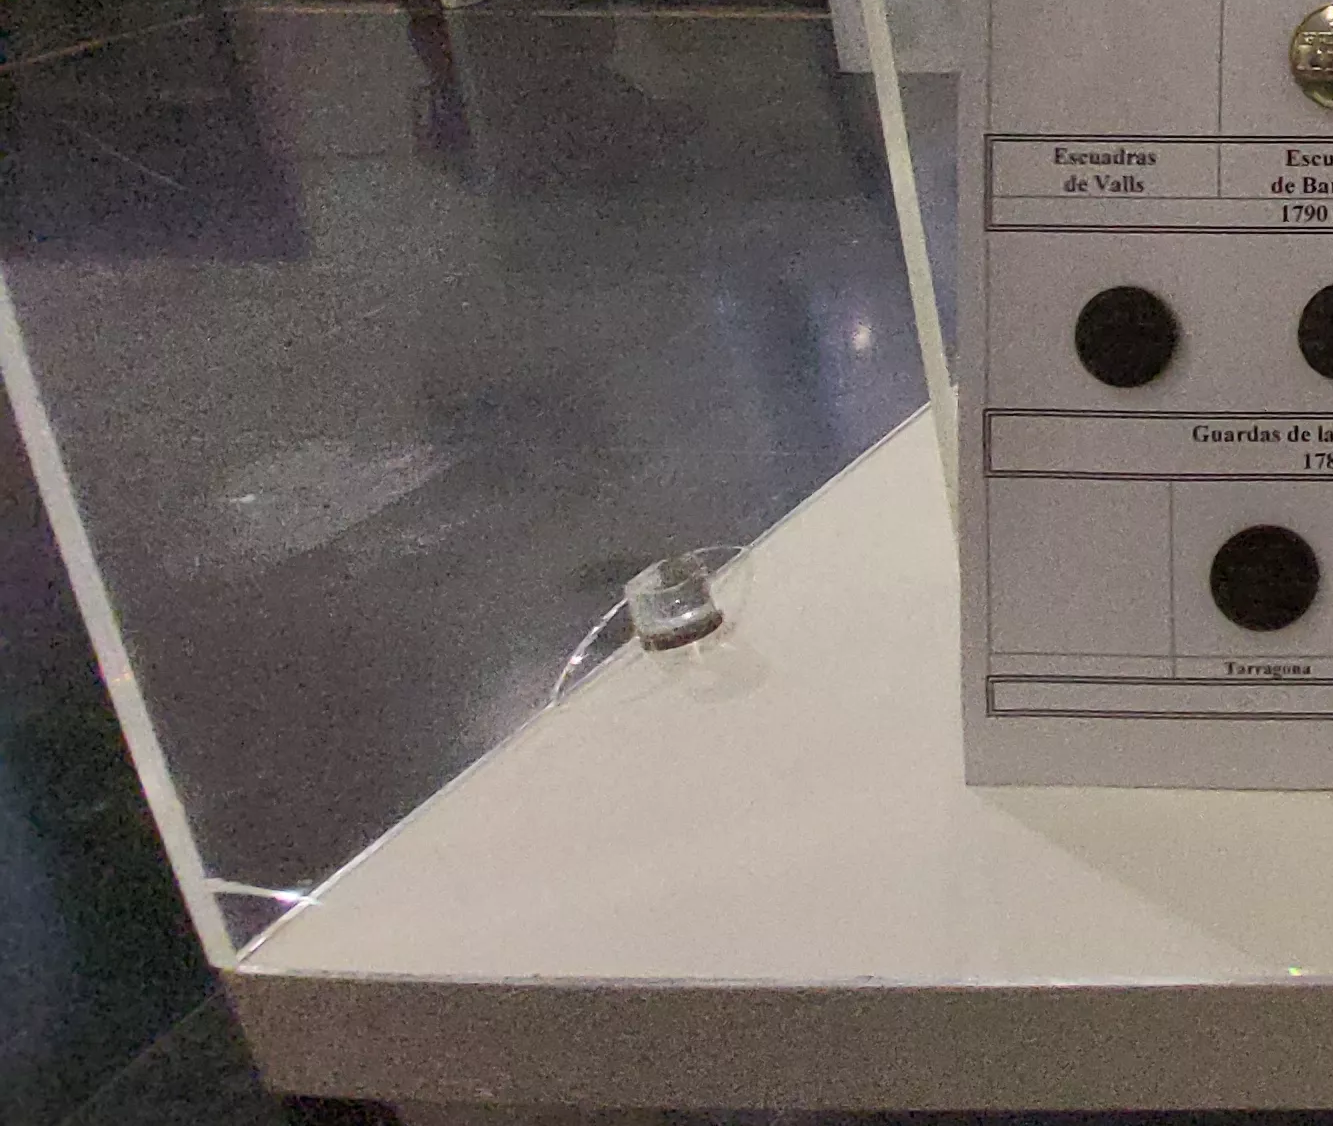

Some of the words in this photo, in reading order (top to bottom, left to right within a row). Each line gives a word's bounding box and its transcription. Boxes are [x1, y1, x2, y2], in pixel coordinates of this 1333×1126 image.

[1053, 146, 1157, 167] Escuadras
[1063, 174, 1089, 193] de
[1093, 174, 1145, 194] Valls
[1270, 176, 1297, 195] de
[1282, 204, 1329, 223] 1790
[1192, 424, 1281, 443] Guardas
[1286, 424, 1311, 443] de
[1224, 660, 1311, 679] Tarragona
